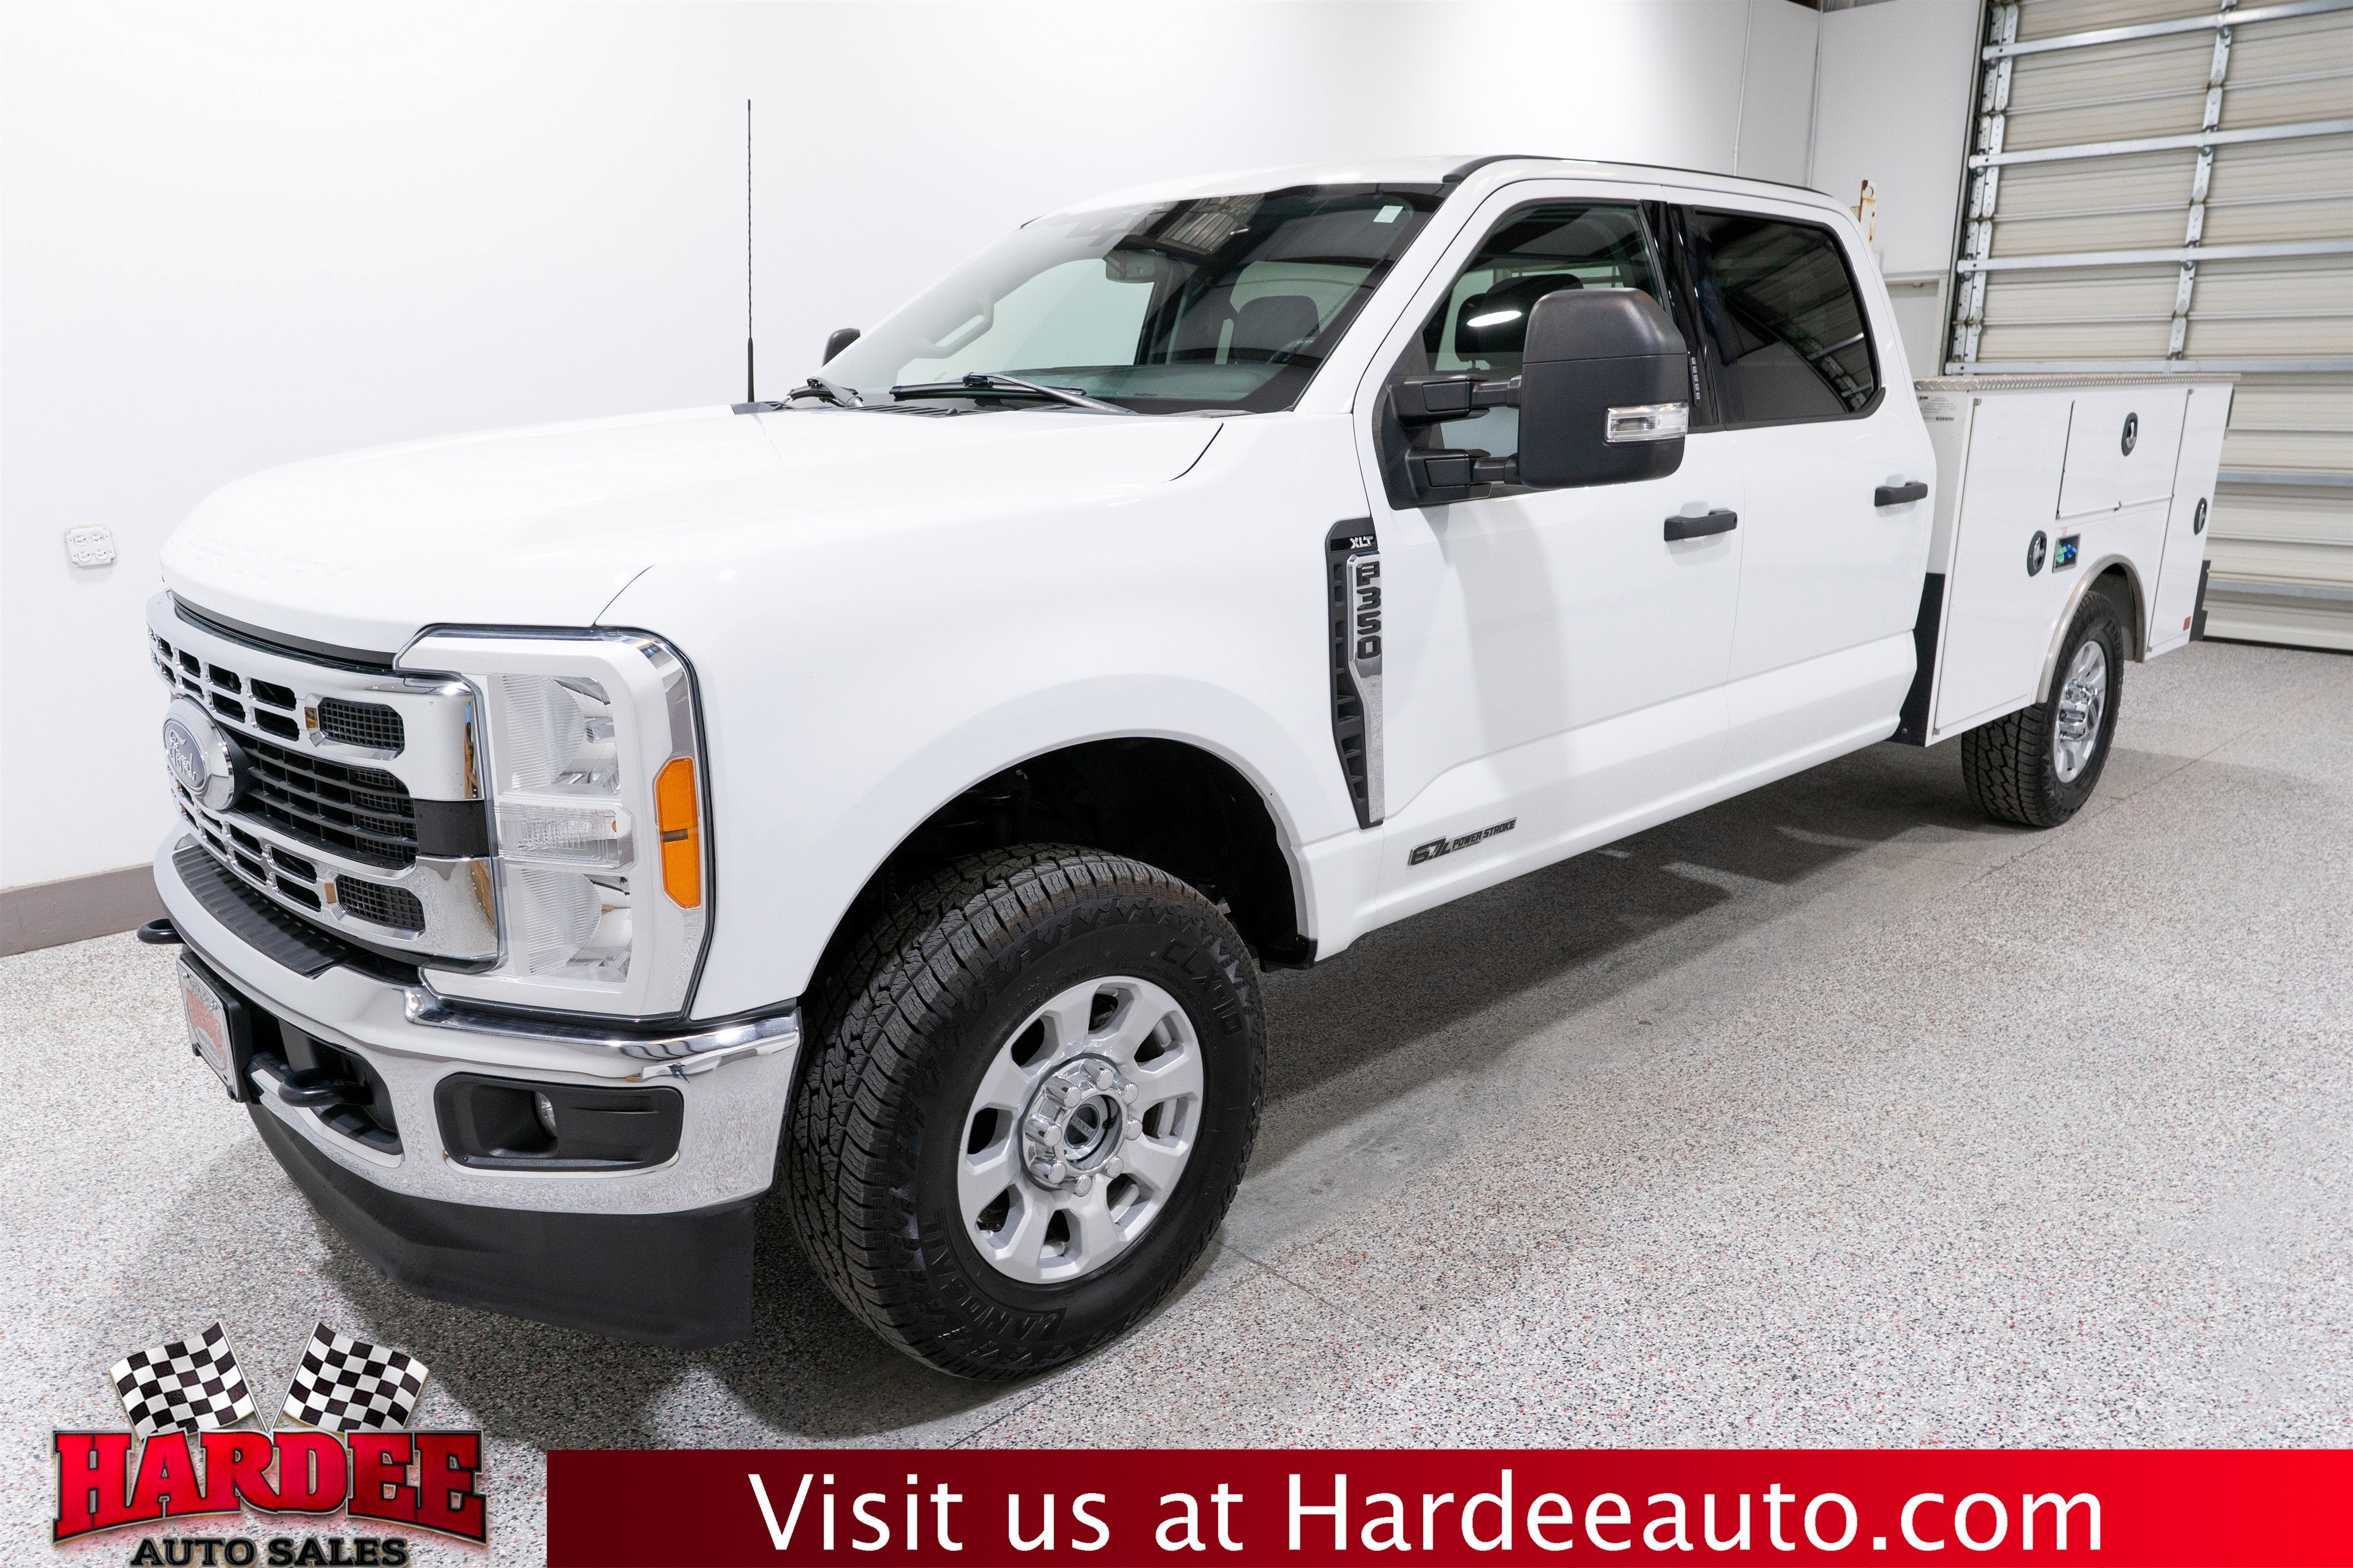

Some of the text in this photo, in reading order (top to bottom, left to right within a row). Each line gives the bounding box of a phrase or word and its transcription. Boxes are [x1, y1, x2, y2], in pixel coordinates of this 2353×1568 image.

[1349, 535, 1374, 549] XLT
[1356, 561, 1382, 660] F350
[169, 728, 196, 781] Ford
[1410, 819, 1517, 866] 6.7L POWER STROKE
[1160, 938, 1243, 1037] CLX-10
